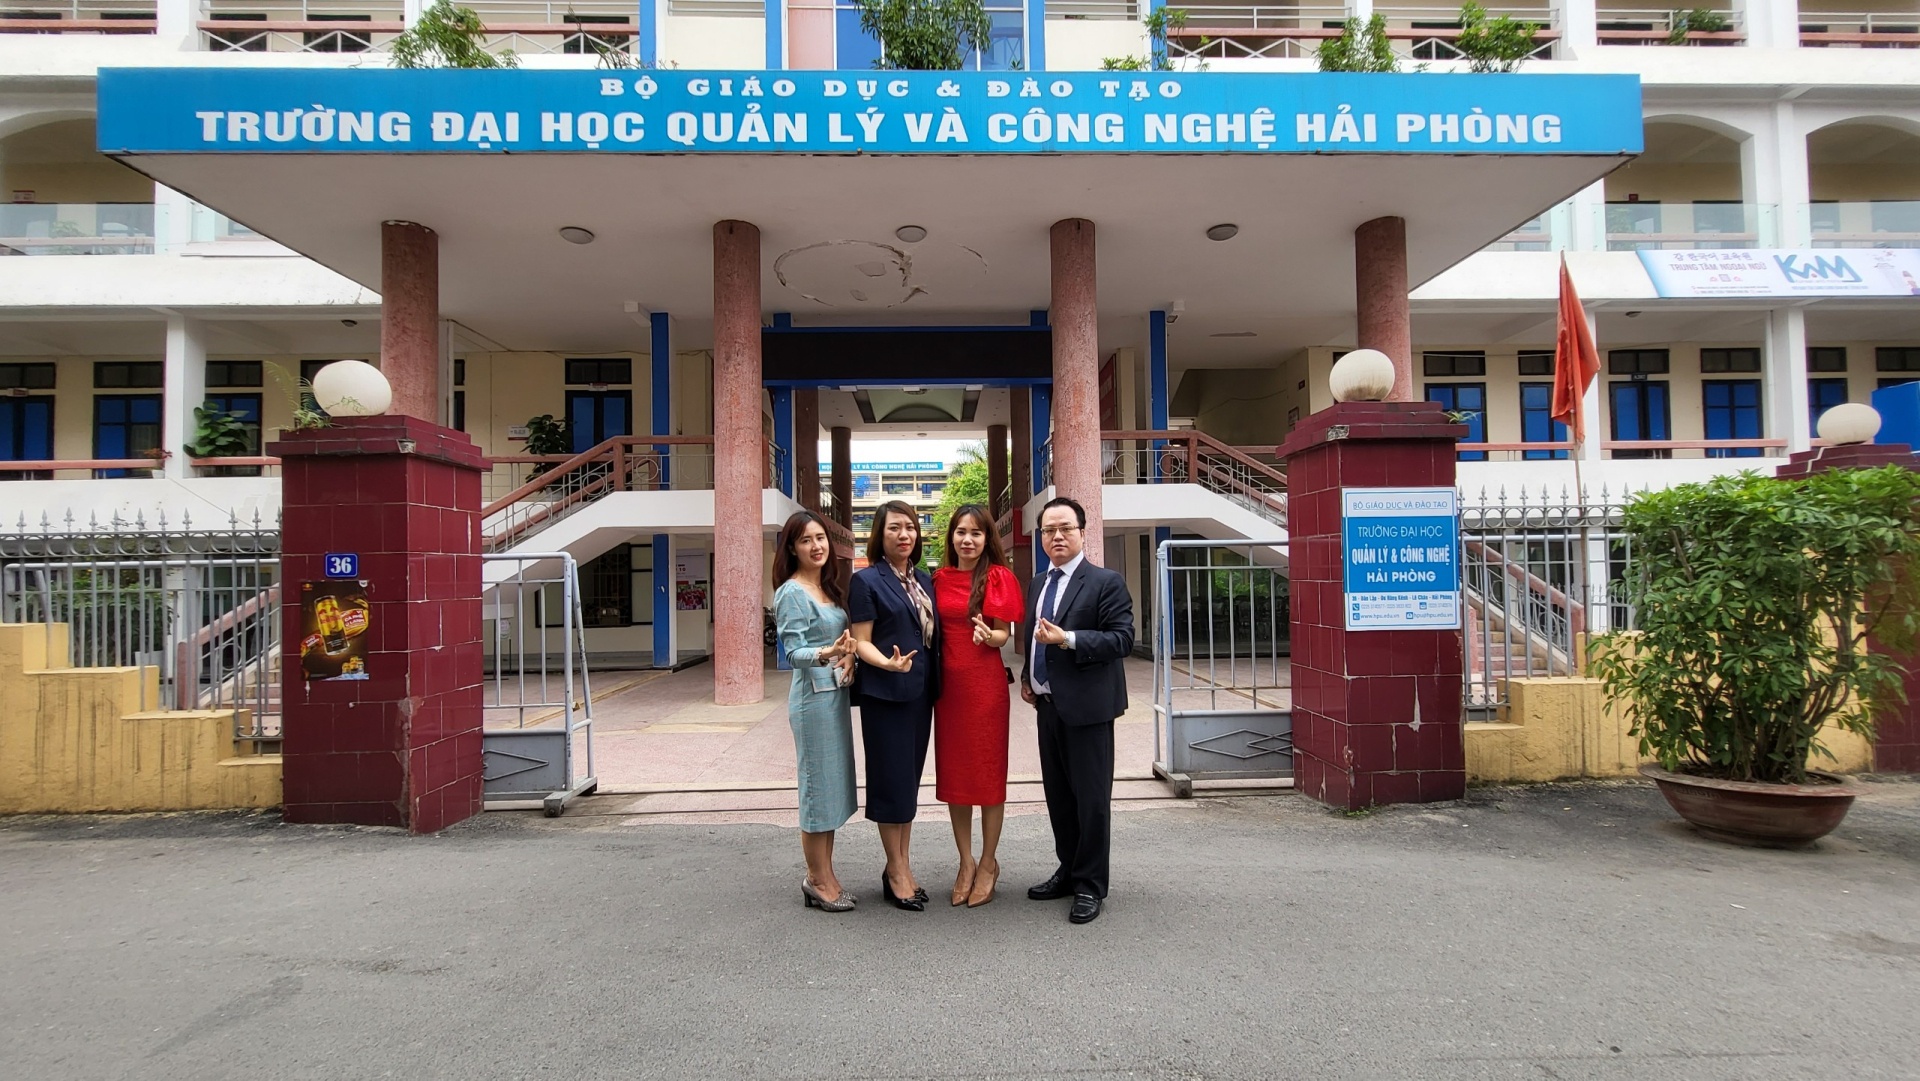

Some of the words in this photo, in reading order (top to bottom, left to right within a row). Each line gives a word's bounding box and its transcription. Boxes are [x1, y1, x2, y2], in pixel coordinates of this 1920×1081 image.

[601, 75, 657, 100] BỘ
[687, 75, 796, 98] GIÁO
[823, 80, 909, 100] DỤC
[936, 79, 961, 98] &
[987, 76, 1074, 98] ĐÀO
[1099, 80, 1182, 102] TẠO
[195, 104, 411, 142] TRƯỜNG
[430, 111, 519, 149] ĐẠI
[541, 111, 645, 149] HỌC
[667, 103, 808, 146] QUẢN
[828, 107, 885, 143] LÝ
[903, 107, 969, 143] VÀ
[987, 107, 1124, 143] CÔNG
[1144, 107, 1277, 149] NGHỆ
[1296, 104, 1377, 143] HẢI
[1396, 107, 1562, 144] PHÒNG
[1669, 263, 1699, 271] TRUNG
[1699, 263, 1718, 271] TÂM
[1719, 263, 1747, 271] NGOẠI
[1353, 501, 1363, 509] BỘ
[1365, 501, 1384, 509] GIÁO
[1415, 500, 1431, 508] ĐÀO
[1358, 524, 1398, 537] TRƯỜNG
[1400, 526, 1418, 539] ĐẠI
[1420, 526, 1443, 538] HỌC
[1352, 543, 1376, 565] QUẢN
[1378, 545, 1388, 563] LÝ
[1391, 548, 1398, 563] &
[1400, 544, 1424, 563] CÔNG
[1426, 544, 1450, 565] NGHỆ
[330, 557, 352, 573] 36
[1366, 568, 1388, 582] HẢI
[1391, 568, 1436, 582] PHÒNG
